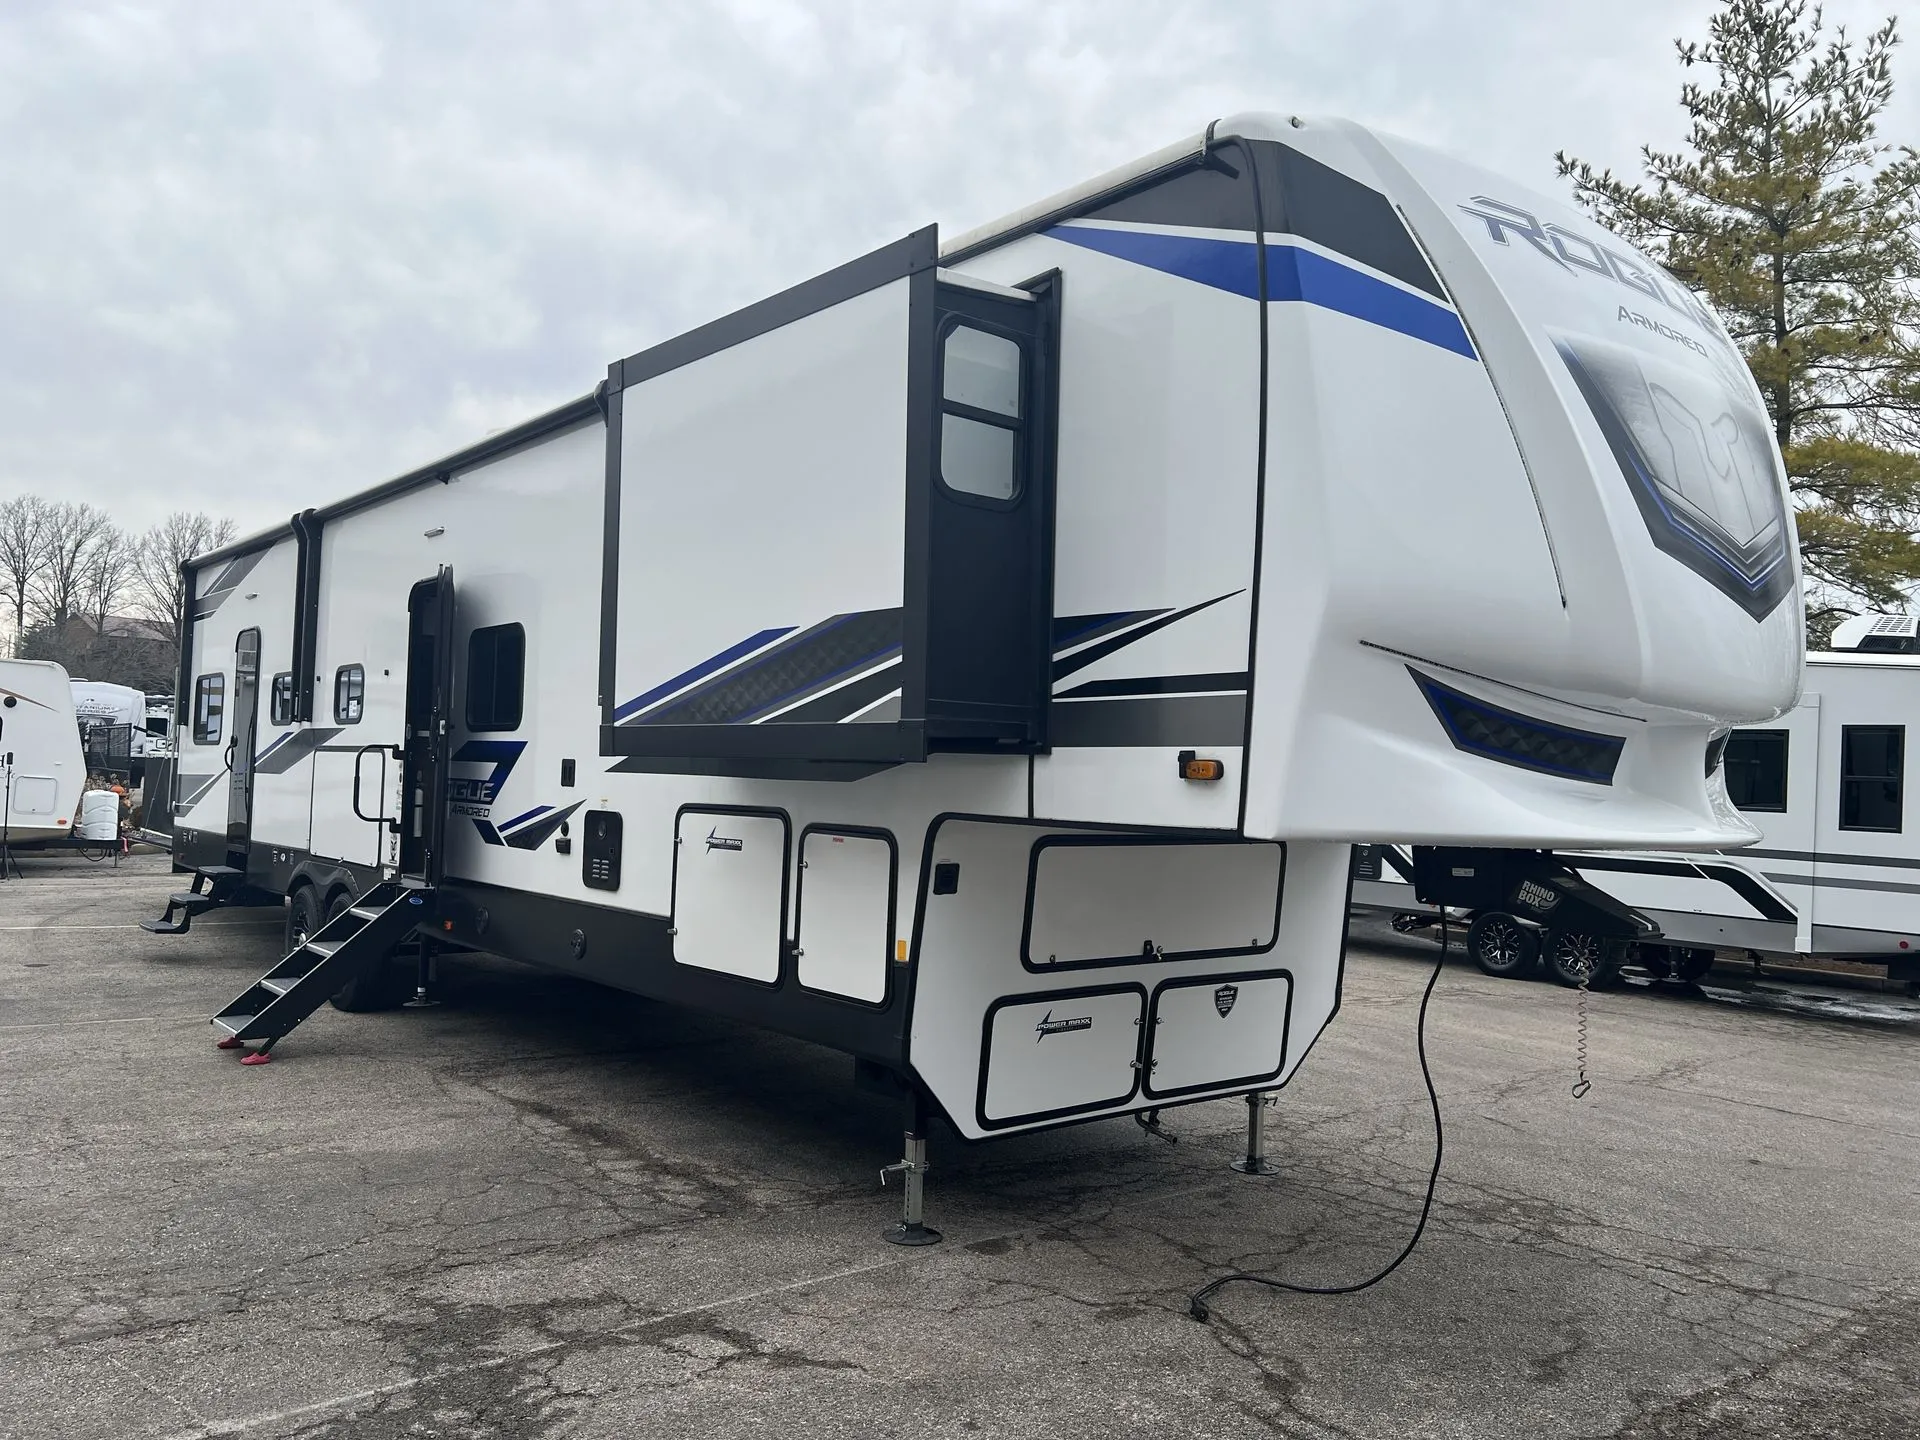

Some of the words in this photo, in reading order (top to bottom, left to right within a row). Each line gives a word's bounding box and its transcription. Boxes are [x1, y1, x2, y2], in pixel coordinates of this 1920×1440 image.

[1617, 304, 1709, 359] ARMORED
[451, 804, 490, 817] ARMORED
[1518, 889, 1541, 907] BOX
[1522, 880, 1554, 901] RHINO
[1037, 1021, 1066, 1029] POWER
